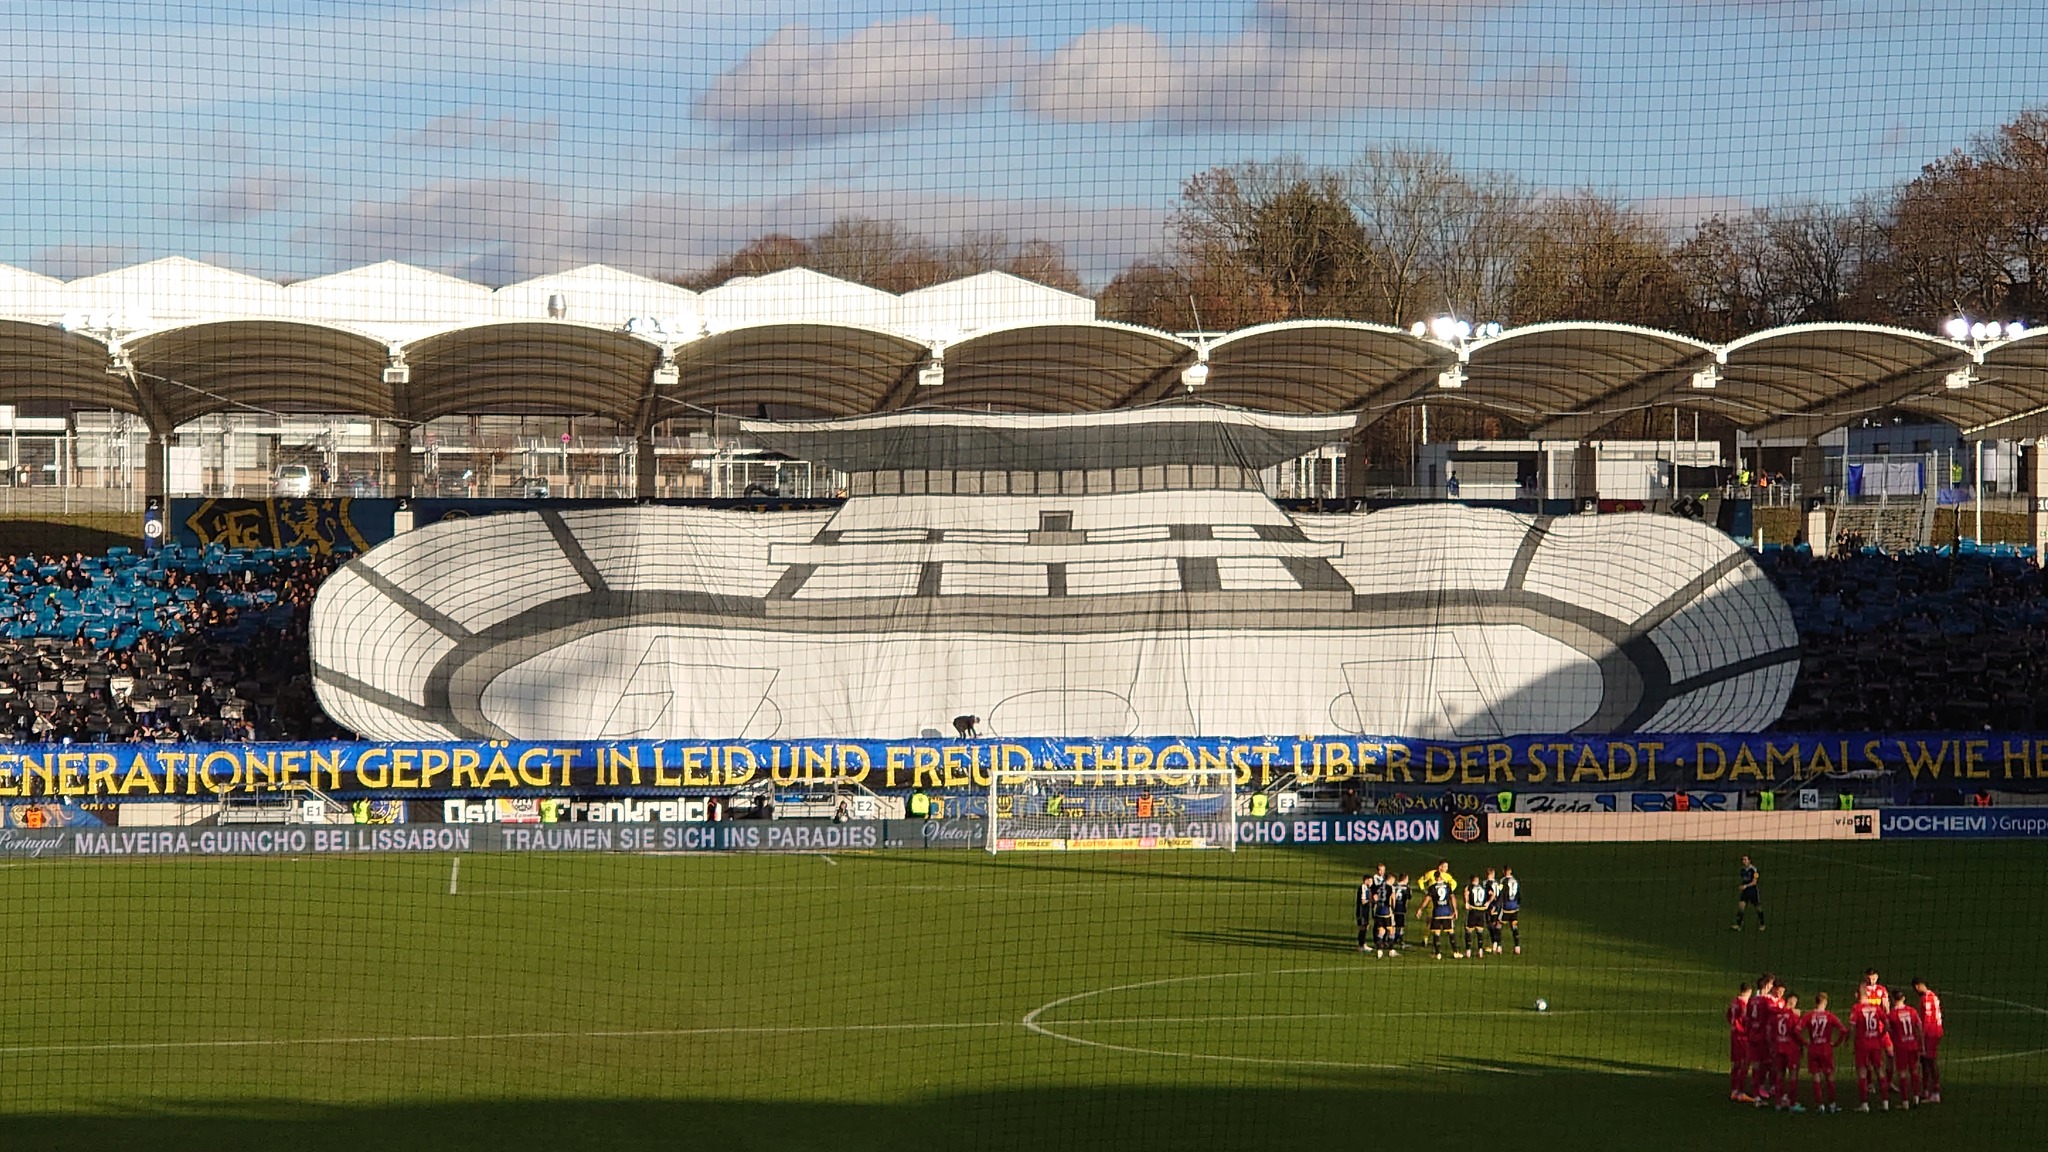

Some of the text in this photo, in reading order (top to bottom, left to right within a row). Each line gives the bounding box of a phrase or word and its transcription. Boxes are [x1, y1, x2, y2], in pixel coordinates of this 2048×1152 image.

[356, 740, 582, 788] GEPRÄGT
[596, 746, 641, 787] IN
[653, 745, 757, 787] LEID
[771, 744, 871, 787] UND
[885, 745, 1033, 788] FREUD
[1065, 744, 1279, 787] THRONST
[1292, 735, 1414, 784] ÜBER
[1424, 741, 1515, 785] DER
[1527, 741, 1664, 784] STADT
[1896, 739, 1991, 781] WIE
[306, 802, 321, 817] E1
[857, 800, 873, 812] E2
[1801, 793, 1817, 805] E4
[1070, 819, 1440, 843] MALVEIRA-GUINCHO BEI LISSABON
[1882, 815, 1987, 832] JOCHEM
[75, 827, 470, 854] MALVEIRA-GUINCHO BEI LISSABON
[502, 823, 612, 850] TRÄUMEN
[619, 827, 655, 849] SIE
[663, 827, 716, 848] SICH
[723, 827, 760, 848] INS
[767, 825, 877, 848] PARADIES
[1811, 1014, 1828, 1039] 27
